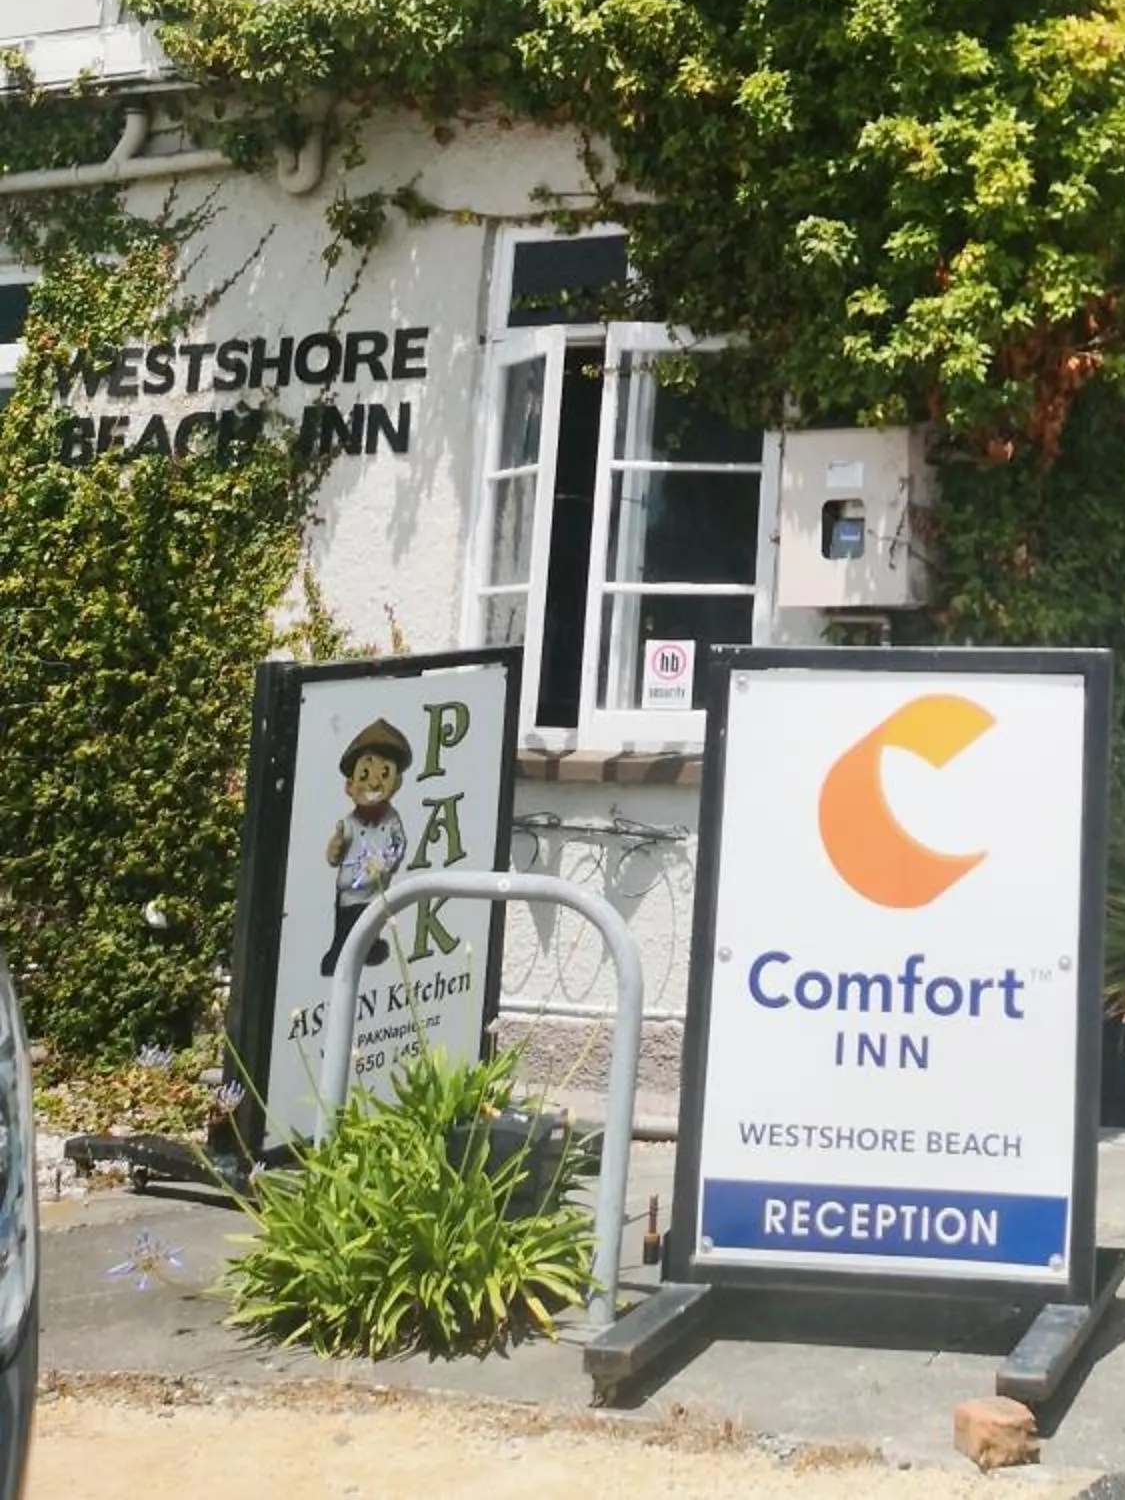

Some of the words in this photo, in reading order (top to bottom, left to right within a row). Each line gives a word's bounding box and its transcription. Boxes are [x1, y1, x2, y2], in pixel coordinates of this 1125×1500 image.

[55, 328, 429, 398] WESTSHORE
[300, 401, 412, 456] INN
[407, 700, 471, 964] PAK
[748, 950, 1025, 1019] Comfort
[288, 989, 377, 1041] ASN
[836, 1031, 929, 1069] INN
[739, 1122, 916, 1154] WESTSHORE
[926, 1130, 1022, 1159] BEACH
[763, 1198, 1000, 1246] RECEPTION
